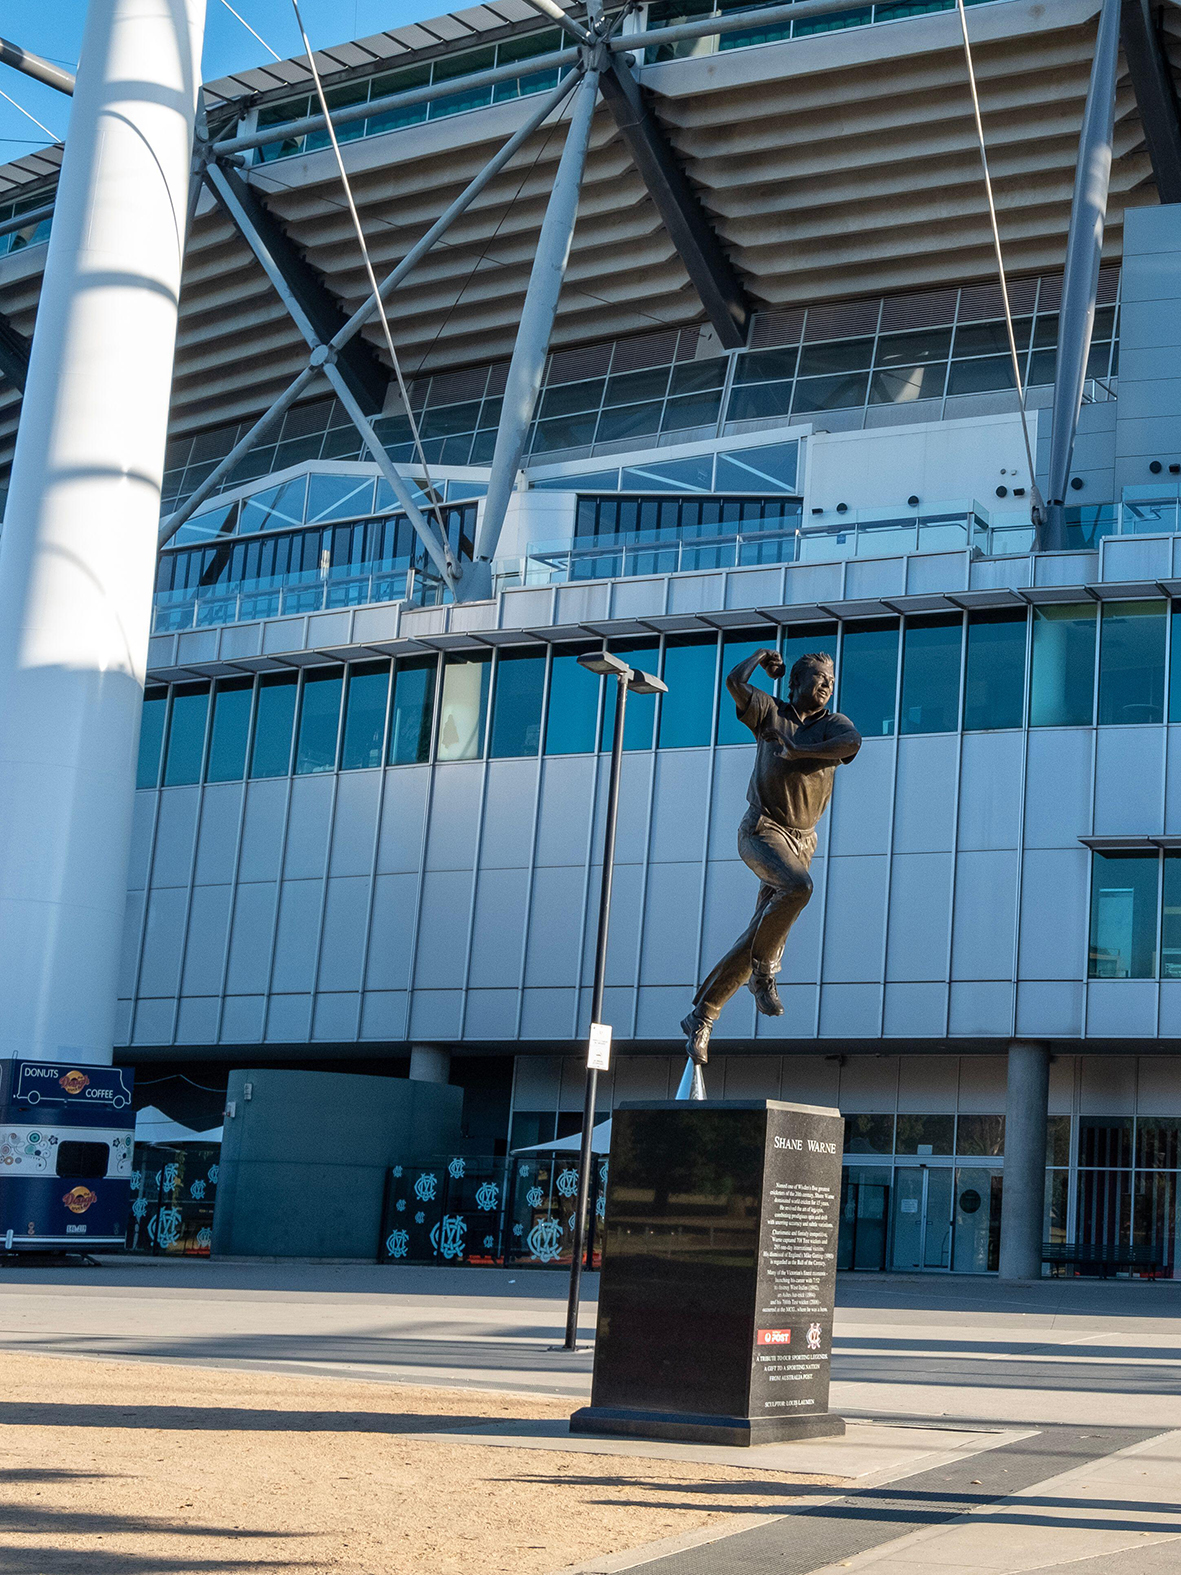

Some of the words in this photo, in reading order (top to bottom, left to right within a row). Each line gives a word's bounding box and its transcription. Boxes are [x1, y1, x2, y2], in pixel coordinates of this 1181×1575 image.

[24, 1067, 59, 1078] DONUTS
[85, 1088, 114, 1099] COFFEE
[774, 1136, 803, 1151] SHANE
[807, 1140, 836, 1154] WARNE
[62, 1191, 97, 1208] Dough
[772, 1333, 789, 1343] POST
